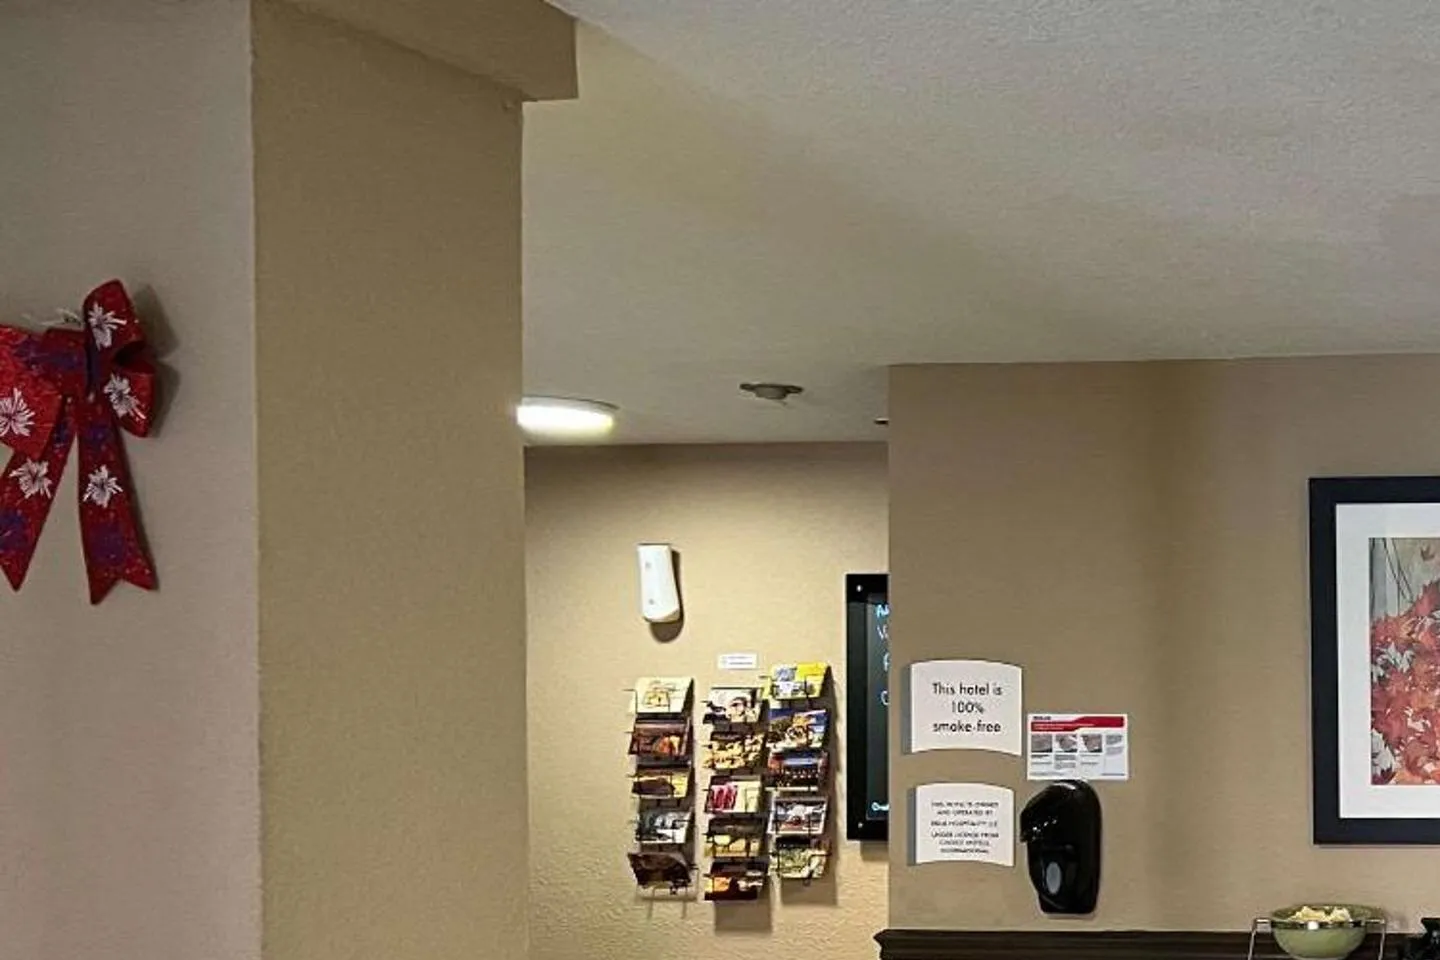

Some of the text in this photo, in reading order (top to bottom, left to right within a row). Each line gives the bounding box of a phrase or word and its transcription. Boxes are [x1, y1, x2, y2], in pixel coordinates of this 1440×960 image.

[932, 681, 1003, 696] This hotel is
[951, 700, 985, 714] 100%
[932, 719, 1002, 733] smoke-free
